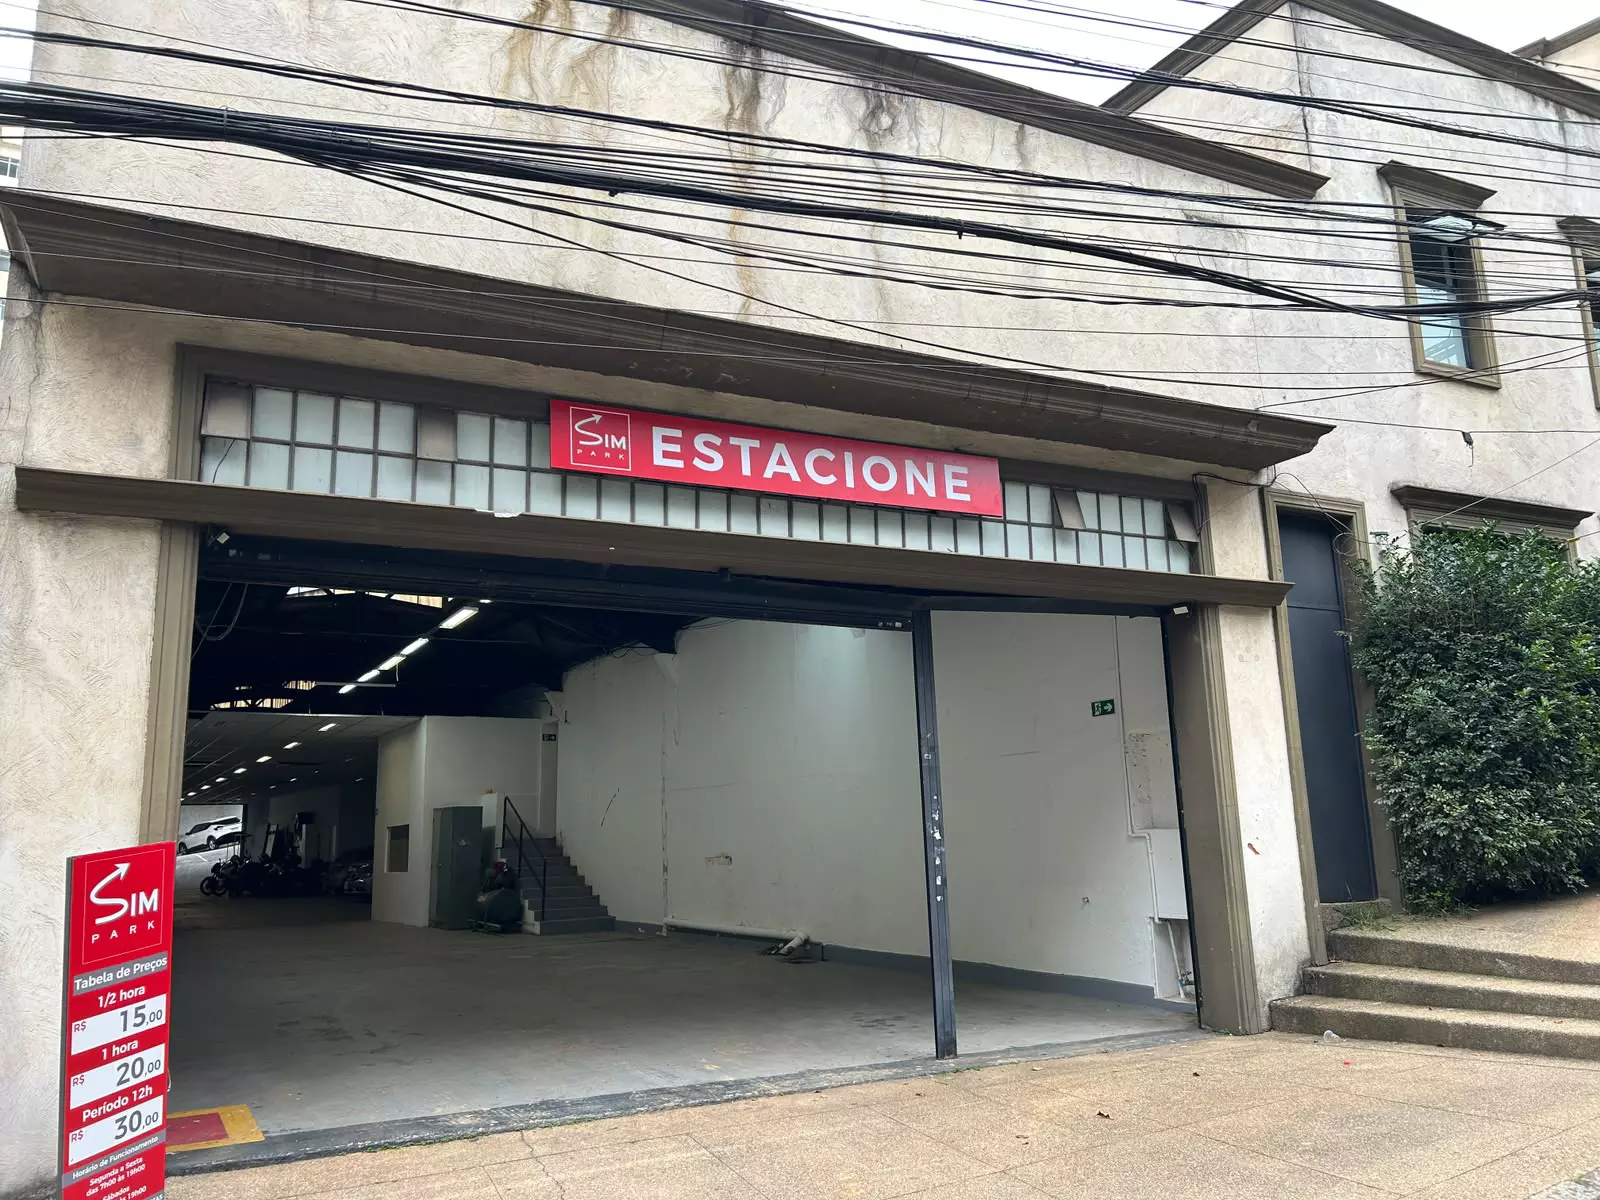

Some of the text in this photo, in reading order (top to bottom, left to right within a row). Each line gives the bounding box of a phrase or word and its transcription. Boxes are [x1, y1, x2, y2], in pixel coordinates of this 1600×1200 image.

[575, 413, 626, 450] SIM
[576, 448, 625, 460] PARK
[652, 426, 971, 502] ESTACIONE
[90, 862, 159, 925] SIM
[91, 920, 155, 944] PARK
[74, 957, 168, 991] Tabela de Preços
[98, 986, 146, 1008] 1/2 hora
[73, 1004, 163, 1033] R$ 15,00
[102, 1040, 139, 1060] 1 hora
[72, 1057, 161, 1087] R$ 20,00
[82, 1085, 153, 1122] Período 12h
[71, 1110, 159, 1143] R$ 30,00
[72, 1135, 159, 1180] Horário de Funcionamento
[89, 1167, 119, 1186] Segunda
[125, 1157, 143, 1169] Sexta
